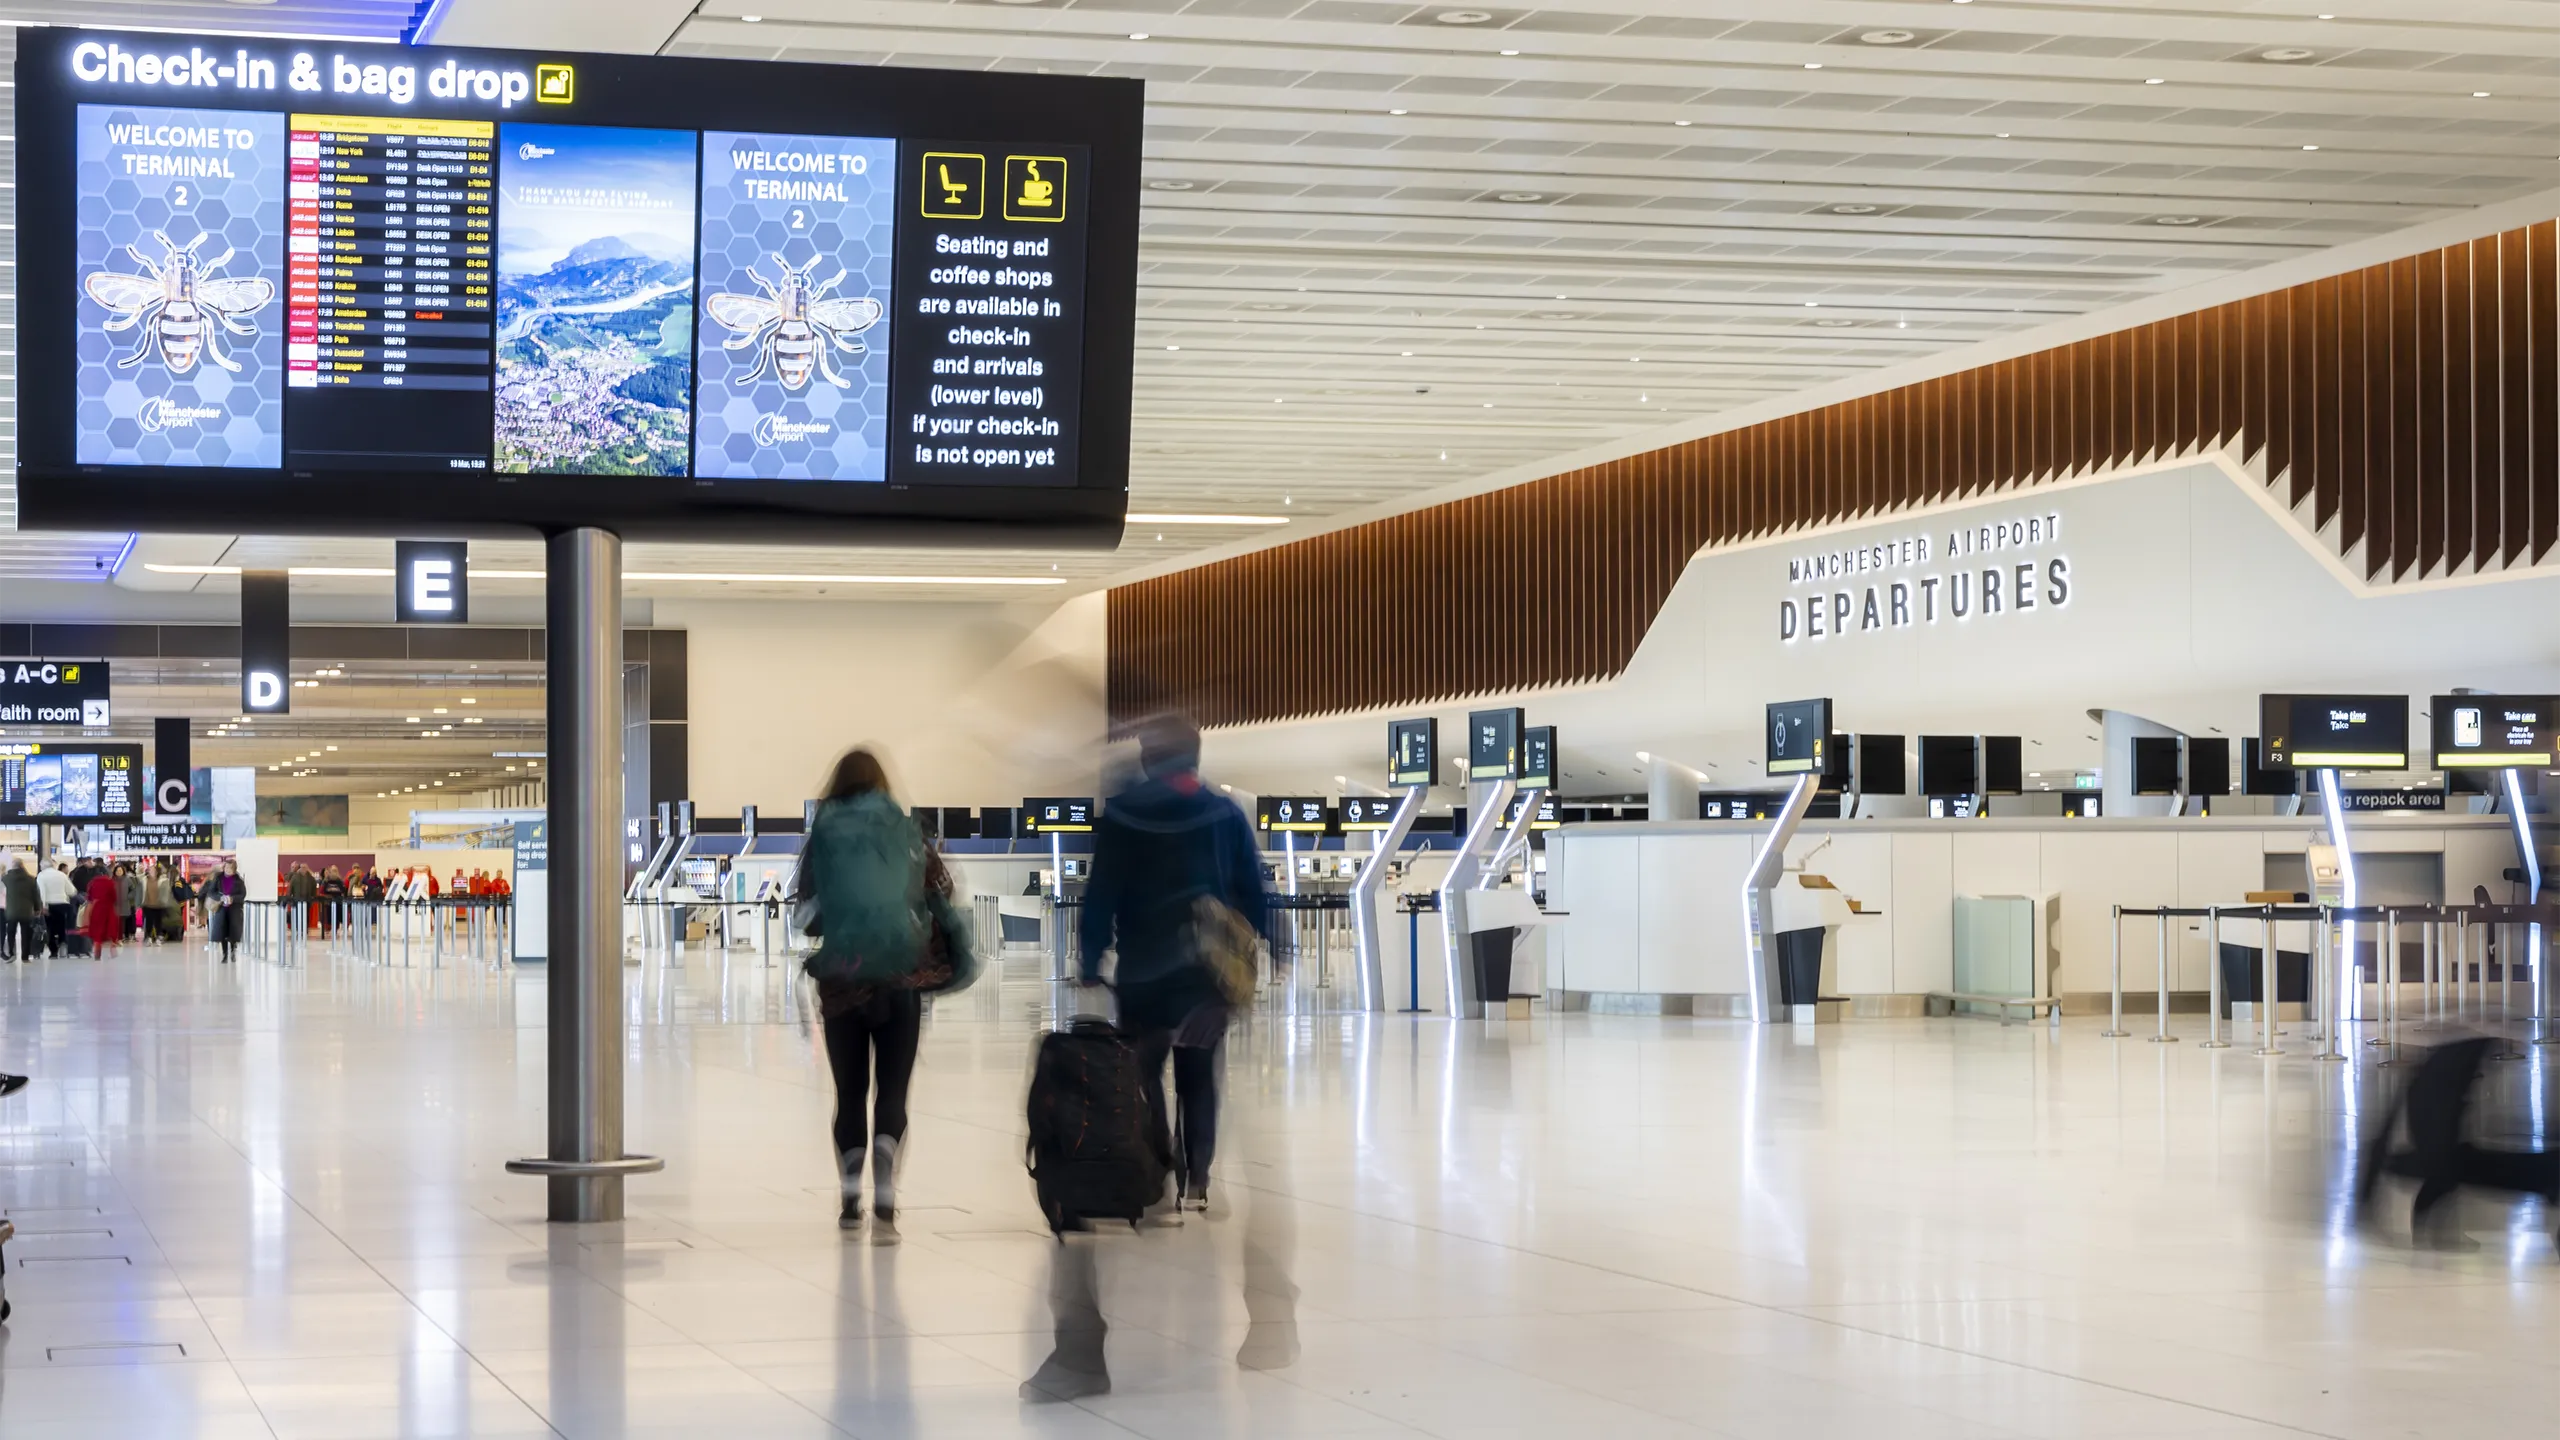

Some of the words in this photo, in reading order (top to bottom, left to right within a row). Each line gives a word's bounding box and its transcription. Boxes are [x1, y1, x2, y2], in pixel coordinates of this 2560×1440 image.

[72, 43, 274, 90] Check-in
[289, 54, 323, 91] &
[334, 55, 415, 102] bag
[429, 61, 530, 108] drop
[108, 124, 220, 148] WELCOME
[223, 129, 254, 150] TO
[122, 154, 235, 178] TERMINAL
[732, 150, 835, 173] WELCOME
[838, 154, 867, 175] TO
[175, 185, 188, 206] 2
[744, 179, 848, 202] TERMINAL
[792, 209, 804, 229] 2
[935, 234, 1008, 258] Seating
[1013, 238, 1049, 256] and
[930, 265, 990, 284] coffee
[995, 267, 1053, 289] shops
[919, 298, 951, 313] are
[955, 296, 1039, 316] available
[1043, 298, 1061, 317] in
[948, 325, 1031, 346] check-in
[933, 356, 969, 374] and
[974, 357, 1043, 376] arrivals
[931, 384, 990, 407] (lower
[994, 386, 1043, 409] level)
[159, 406, 221, 418] Manchester
[159, 416, 193, 428] Airport
[772, 422, 830, 434] Manchester
[913, 414, 927, 433] if
[930, 417, 973, 437] your
[977, 416, 1059, 436] check-in
[772, 432, 804, 443] Airport
[915, 444, 932, 463] is
[937, 446, 969, 463] not
[973, 448, 1020, 467] open
[1025, 447, 1055, 468] yet
[1789, 539, 1928, 582] MANCHESTER
[1948, 515, 2056, 556] AIRPORT
[414, 560, 452, 610] E
[1780, 559, 2068, 641] DEPARTURES
[14, 664, 58, 684] A-C
[250, 672, 281, 707] D
[0, 703, 31, 721] aith
[38, 707, 80, 721] room
[2330, 710, 2349, 721] Take
[2504, 711, 2520, 721] Take
[2330, 721, 2349, 730] Take
[2271, 754, 2283, 762] F3
[158, 778, 188, 812] C
[2356, 792, 2405, 808] repack
[2409, 795, 2440, 806] area
[126, 835, 147, 844] Lifts
[150, 835, 159, 844] to
[161, 835, 184, 844] Zone
[187, 835, 194, 844] H
[130, 825, 169, 834] erminals
